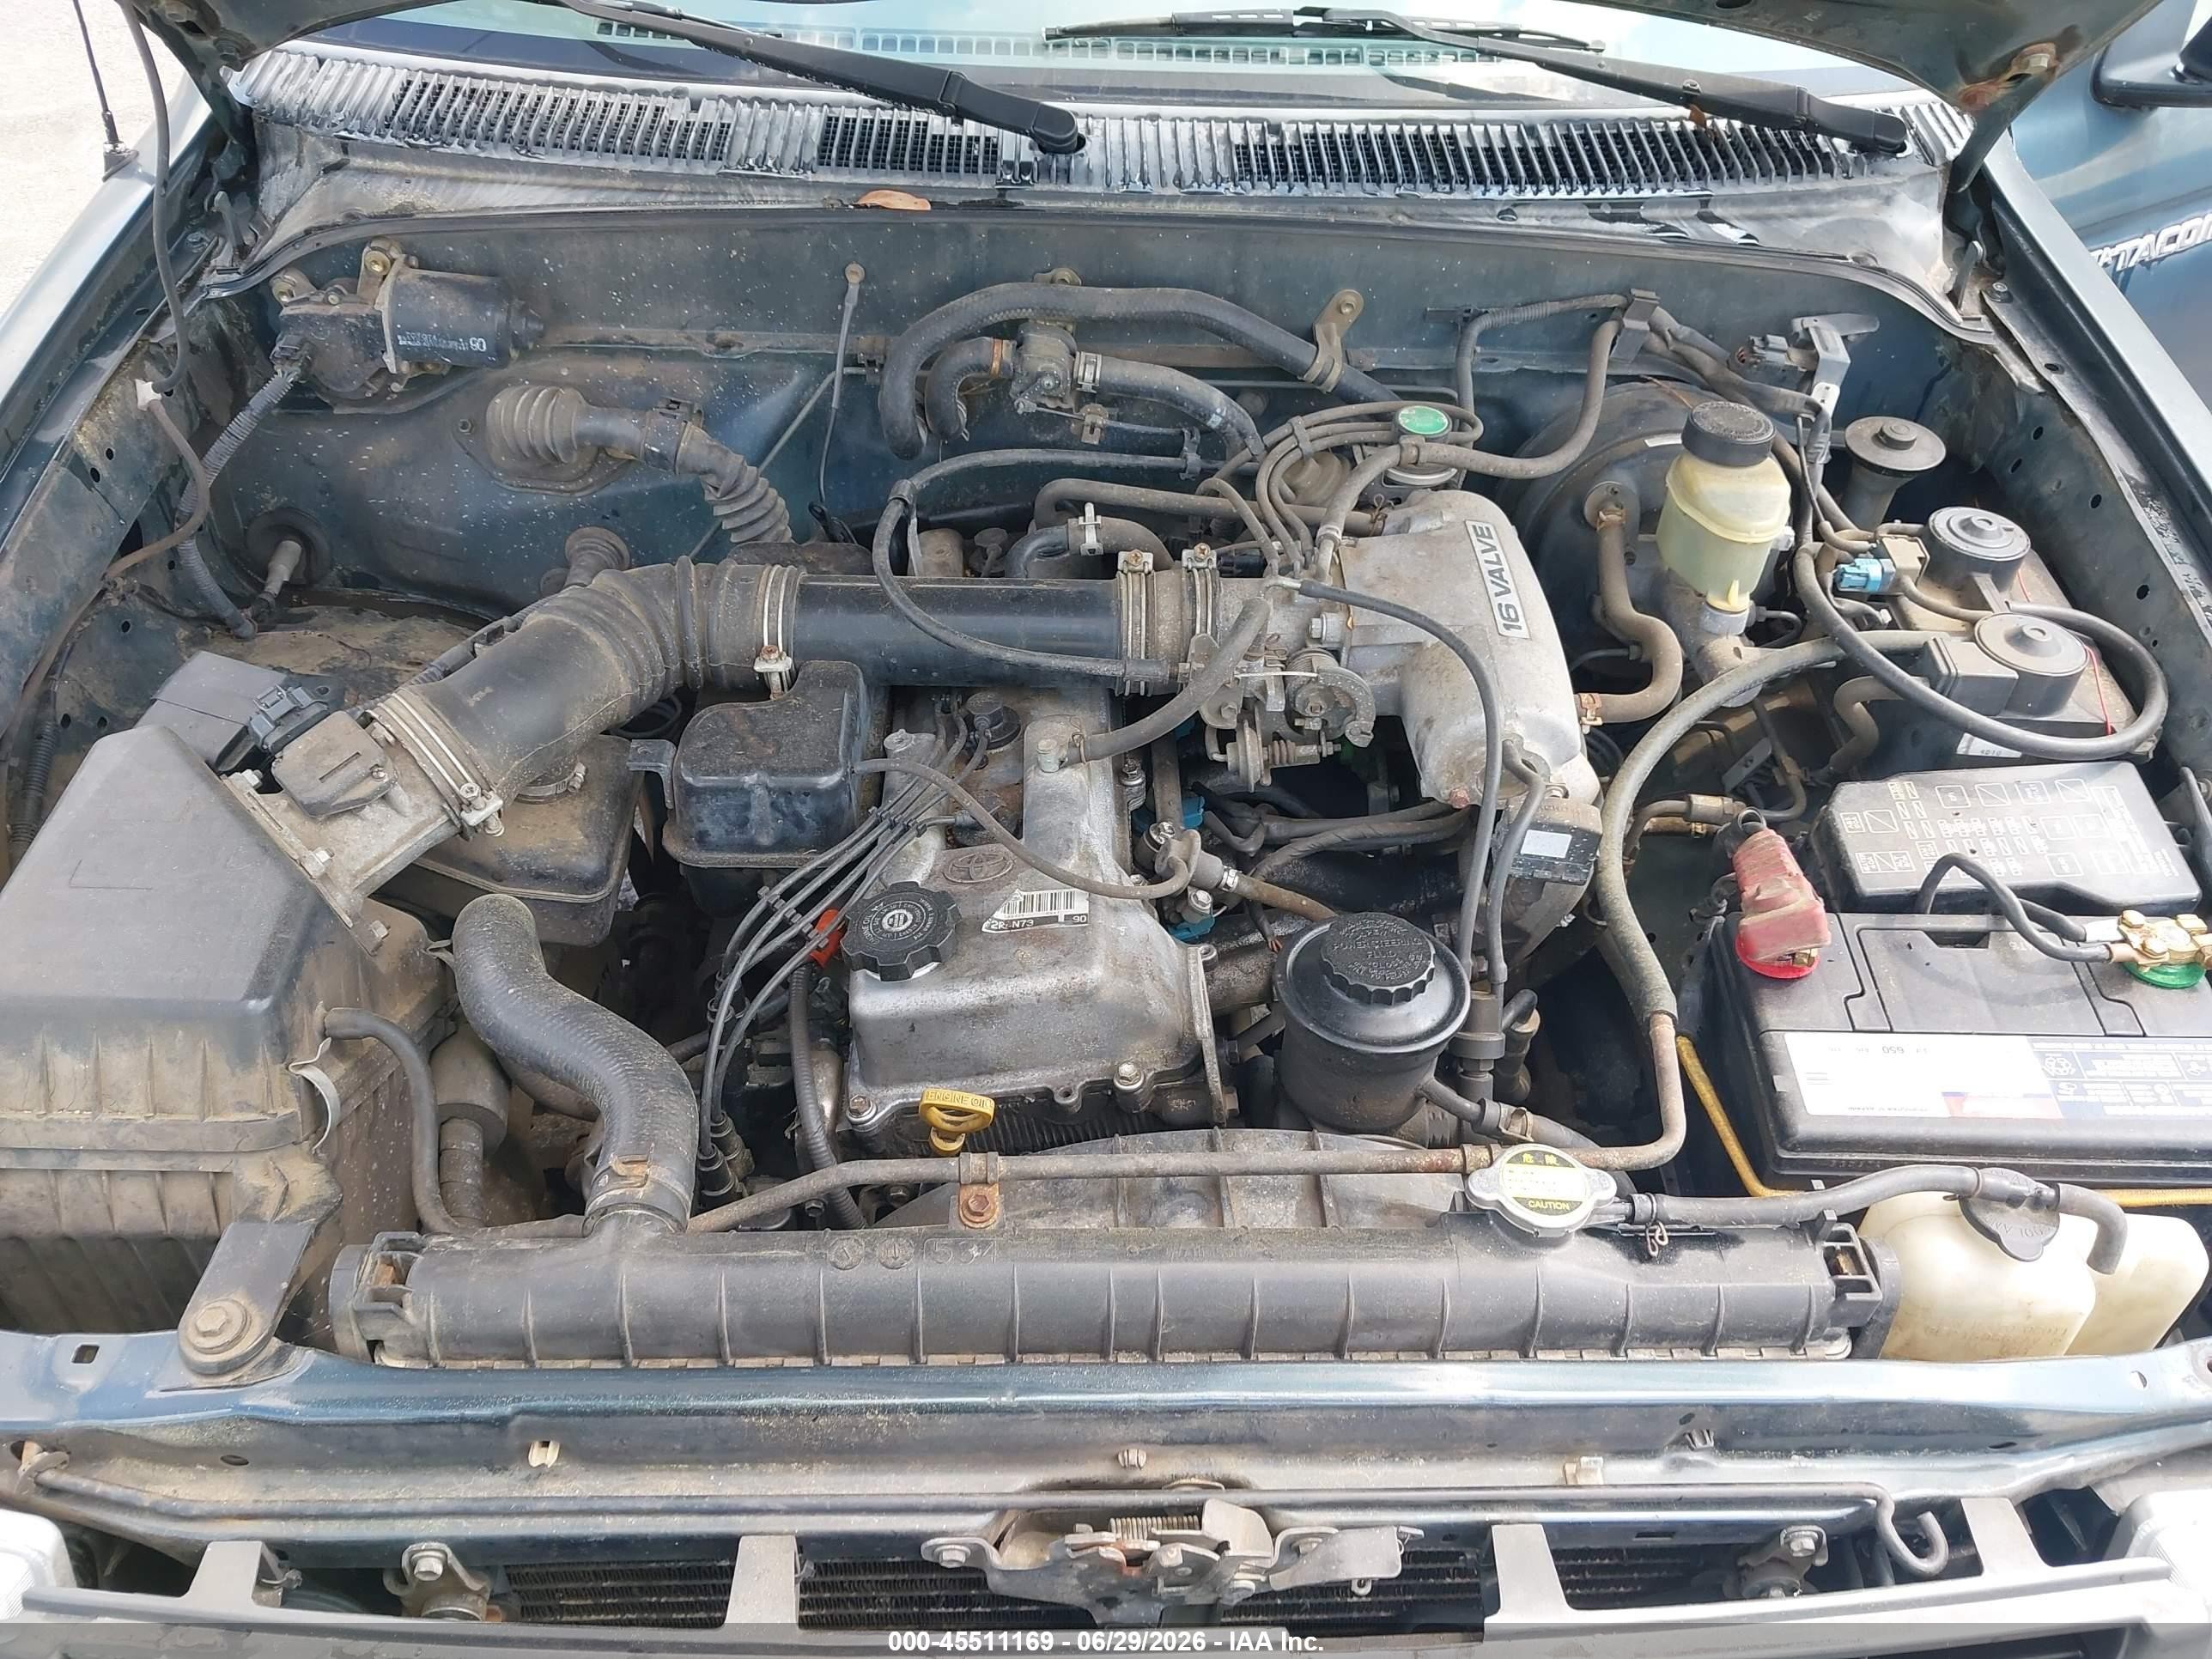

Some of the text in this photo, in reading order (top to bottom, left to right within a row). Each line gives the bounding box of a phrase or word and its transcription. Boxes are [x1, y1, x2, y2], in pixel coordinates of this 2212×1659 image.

[1472, 524, 1522, 631] 16 VALVE
[1072, 915, 1088, 924] 90
[927, 1091, 969, 1106] ENGINE
[1528, 1200, 1570, 1211] CAUTION
